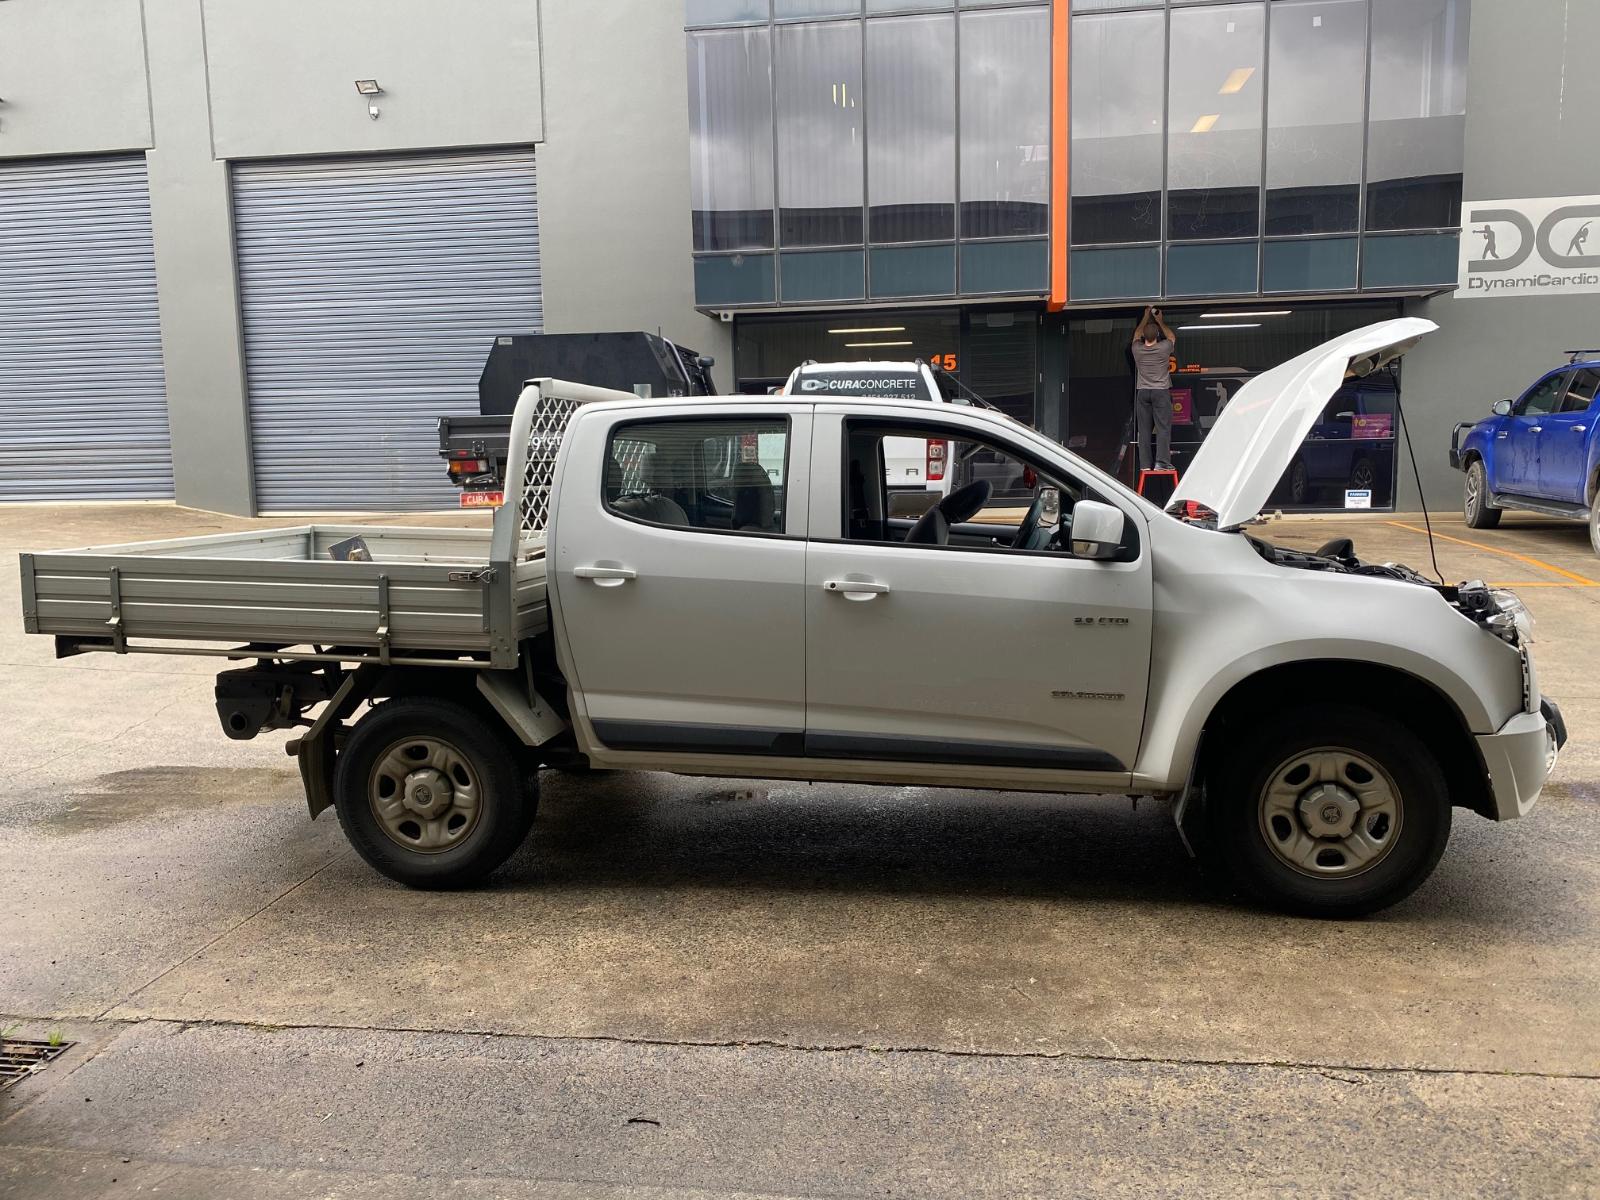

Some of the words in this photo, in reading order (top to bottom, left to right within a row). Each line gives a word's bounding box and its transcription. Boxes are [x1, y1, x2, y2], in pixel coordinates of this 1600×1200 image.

[1468, 272, 1599, 292] DynamiCardio
[930, 354, 957, 371] 15
[829, 379, 916, 389] CURACONCRETE
